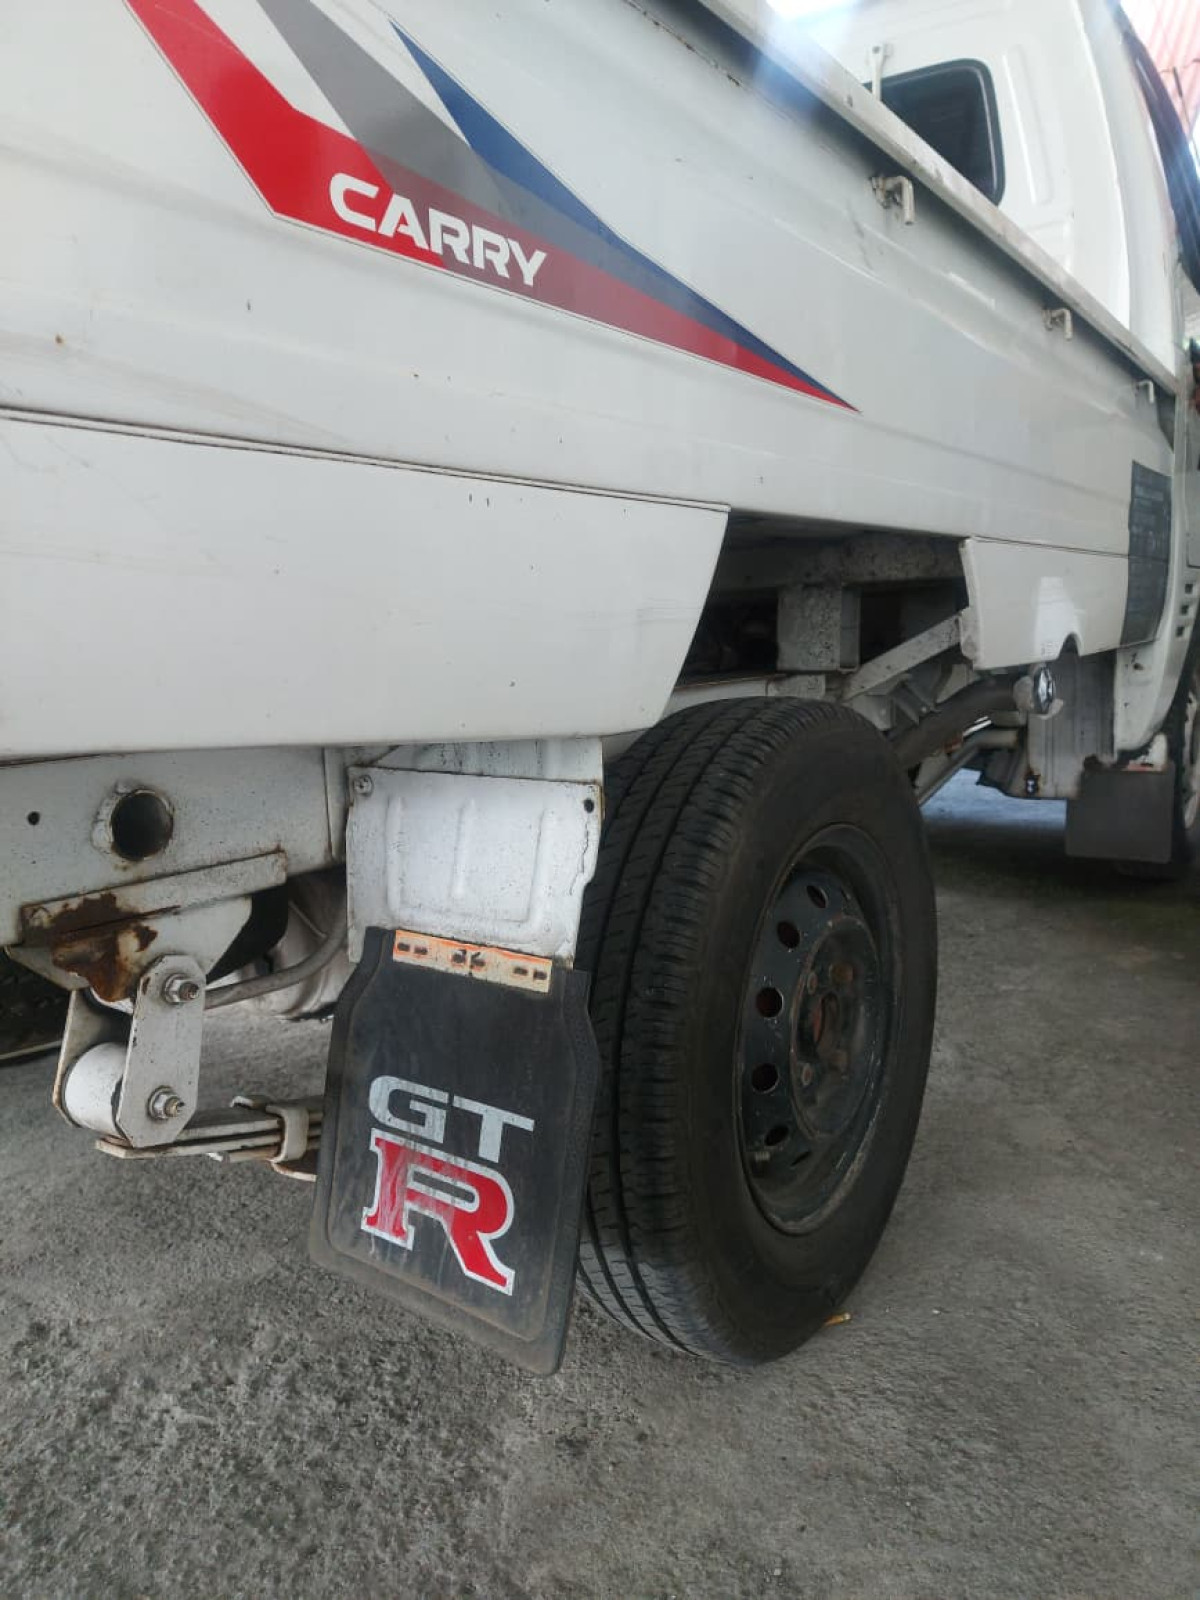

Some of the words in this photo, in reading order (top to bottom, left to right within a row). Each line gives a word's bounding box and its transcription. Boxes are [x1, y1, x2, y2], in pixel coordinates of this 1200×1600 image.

[329, 172, 547, 286] CARRY
[368, 1075, 535, 1163] GT
[361, 1128, 515, 1296] R
